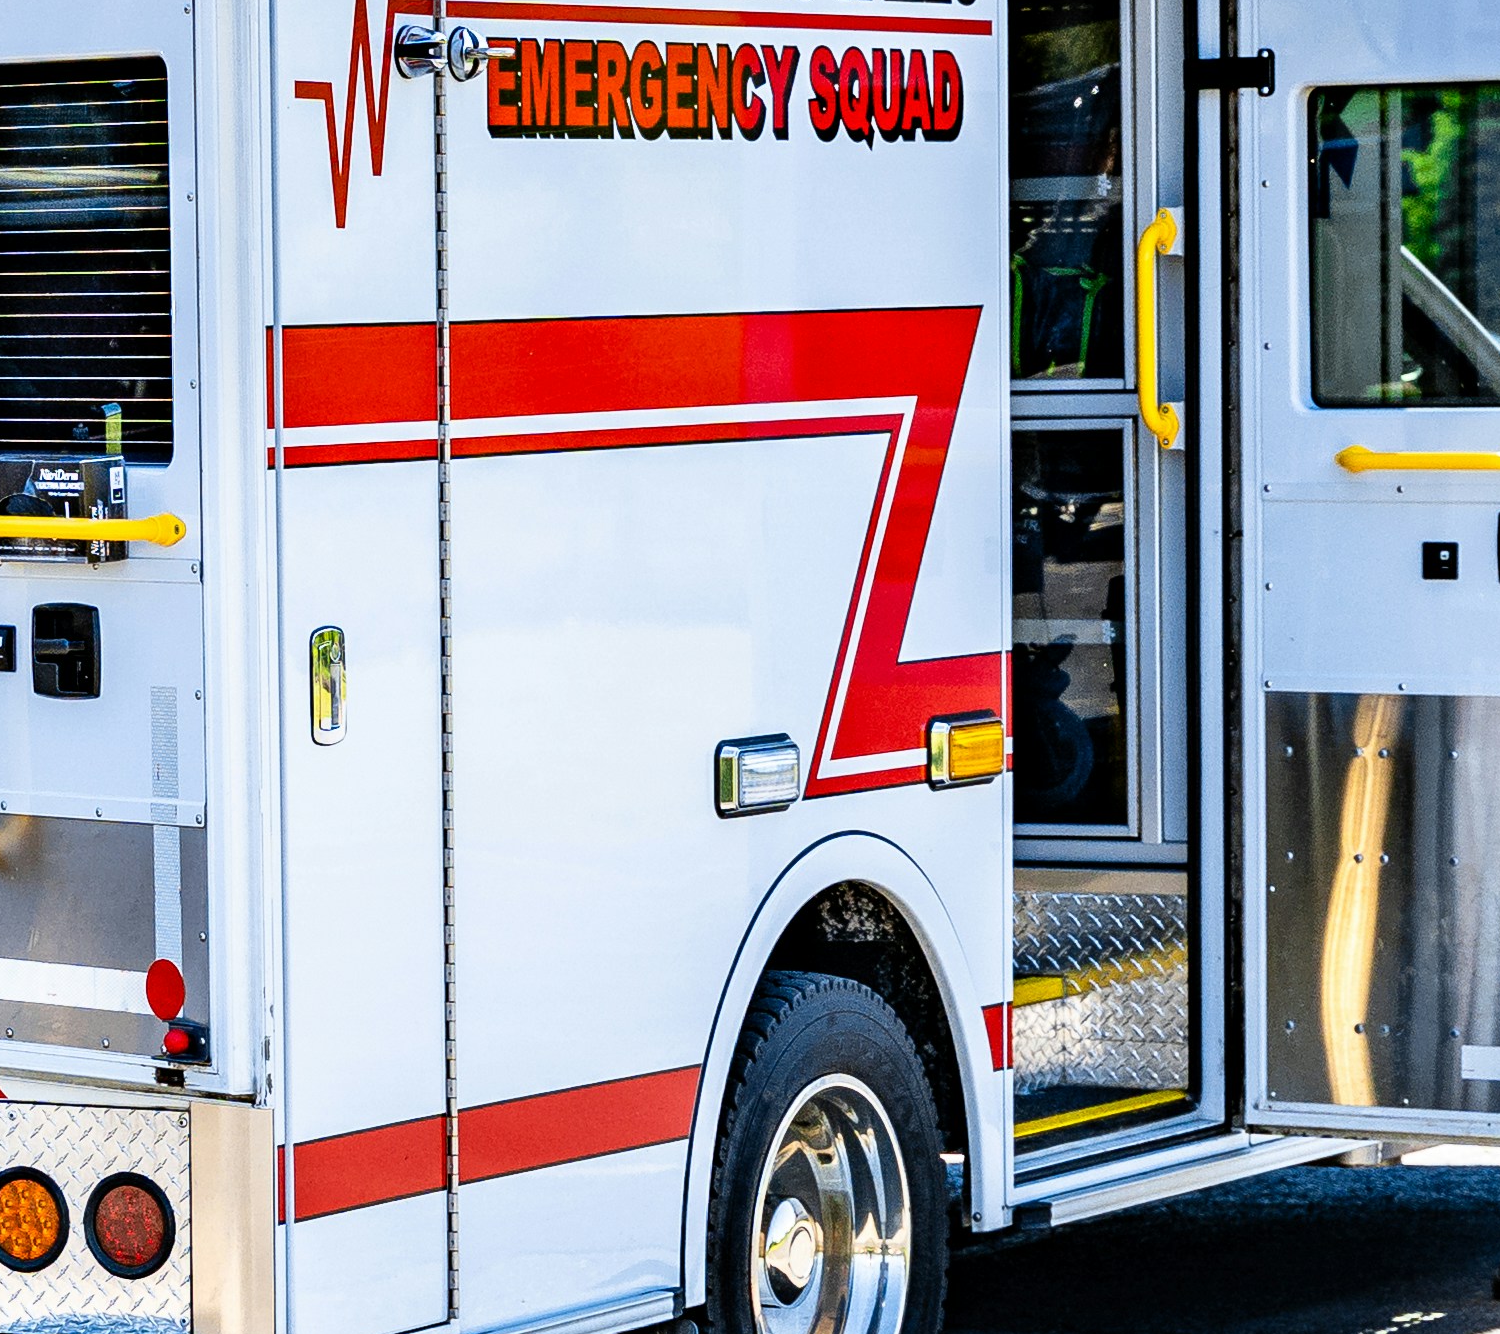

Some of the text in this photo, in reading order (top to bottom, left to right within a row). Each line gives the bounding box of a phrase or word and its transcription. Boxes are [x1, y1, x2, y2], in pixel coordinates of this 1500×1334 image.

[485, 36, 964, 151] EMERGENCY SQUAD
[39, 468, 79, 480] NitriDerm
